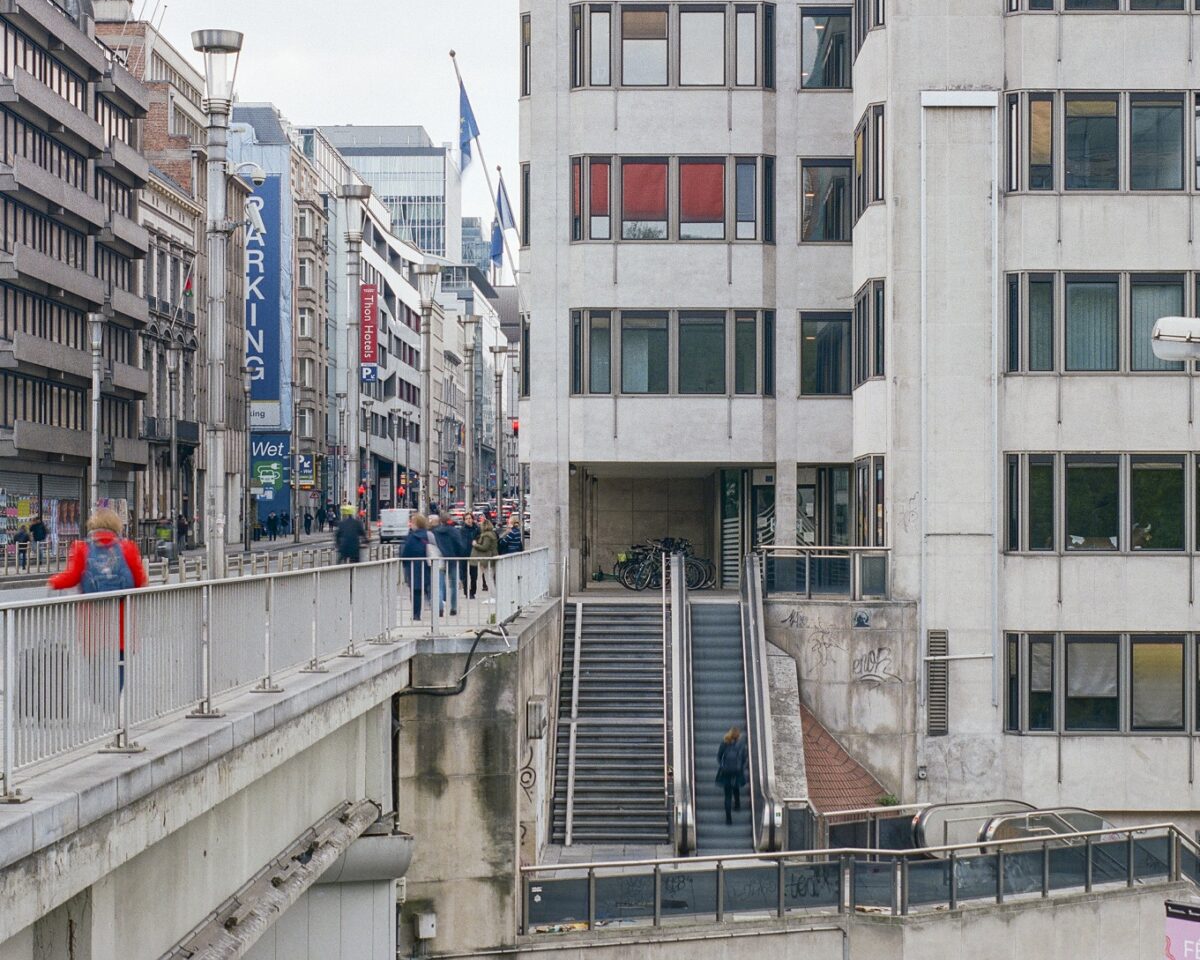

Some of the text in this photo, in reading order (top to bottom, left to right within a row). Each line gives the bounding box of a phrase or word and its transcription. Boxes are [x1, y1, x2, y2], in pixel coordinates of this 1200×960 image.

[364, 296, 374, 321] Thon
[364, 325, 374, 358] Hotels
[363, 368, 372, 378] P
[252, 442, 284, 456] Wet
